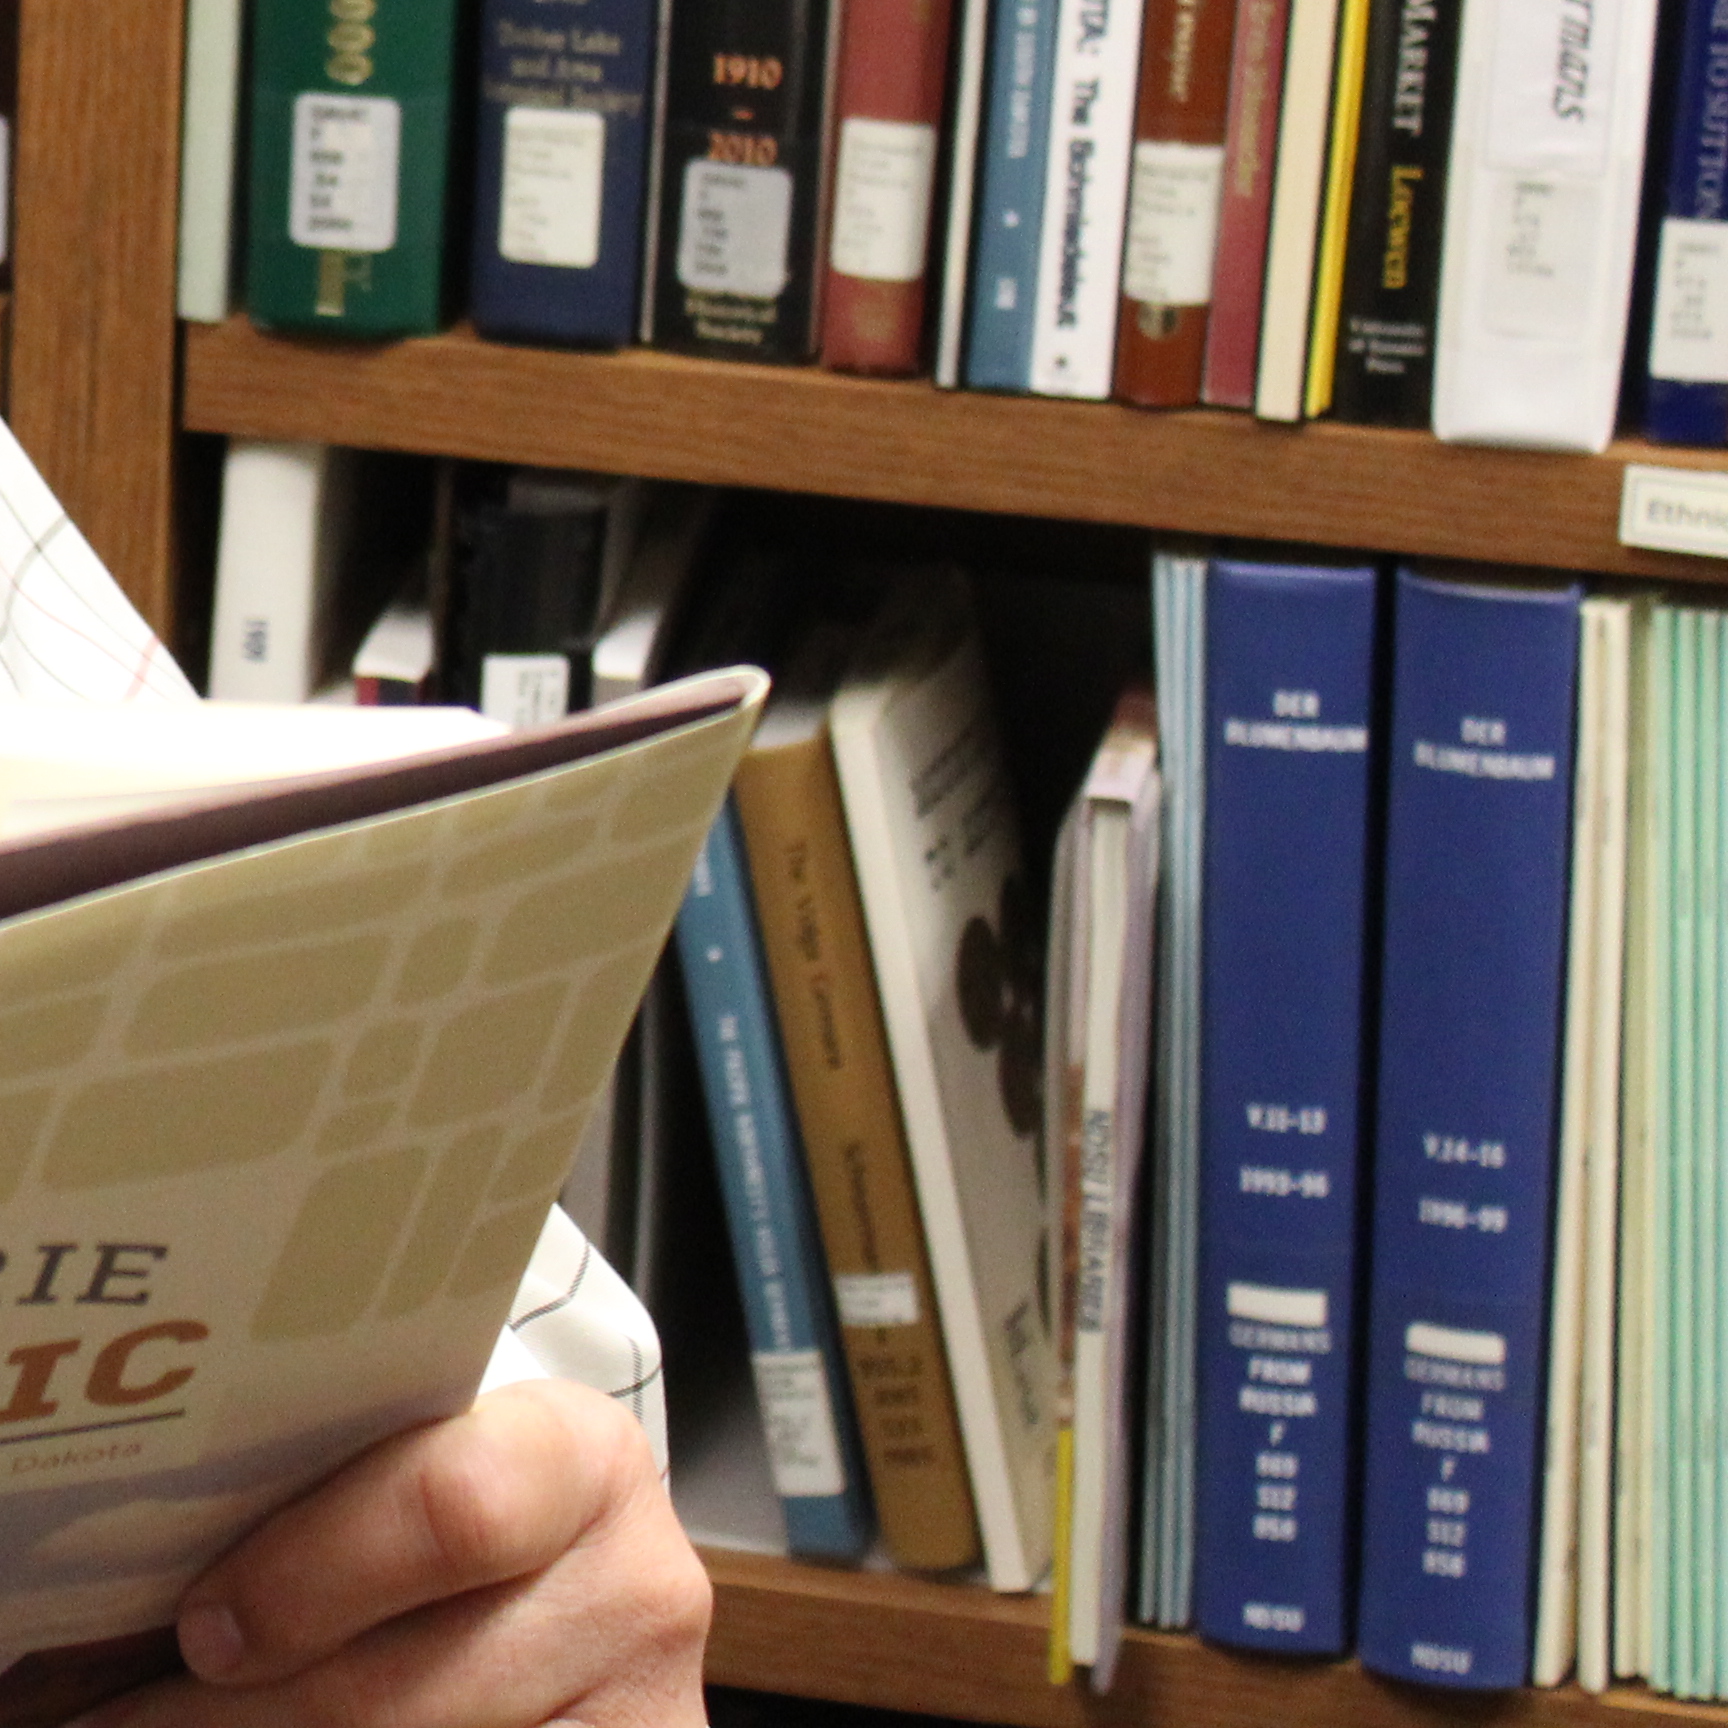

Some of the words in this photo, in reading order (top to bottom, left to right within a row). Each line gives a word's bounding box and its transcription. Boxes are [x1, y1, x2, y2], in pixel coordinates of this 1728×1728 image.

[713, 52, 783, 90] 1910
[1070, 78, 1101, 129] The
[1271, 688, 1321, 718] DER
[1459, 714, 1506, 746] DER
[3, 1440, 144, 1478] Dakota
